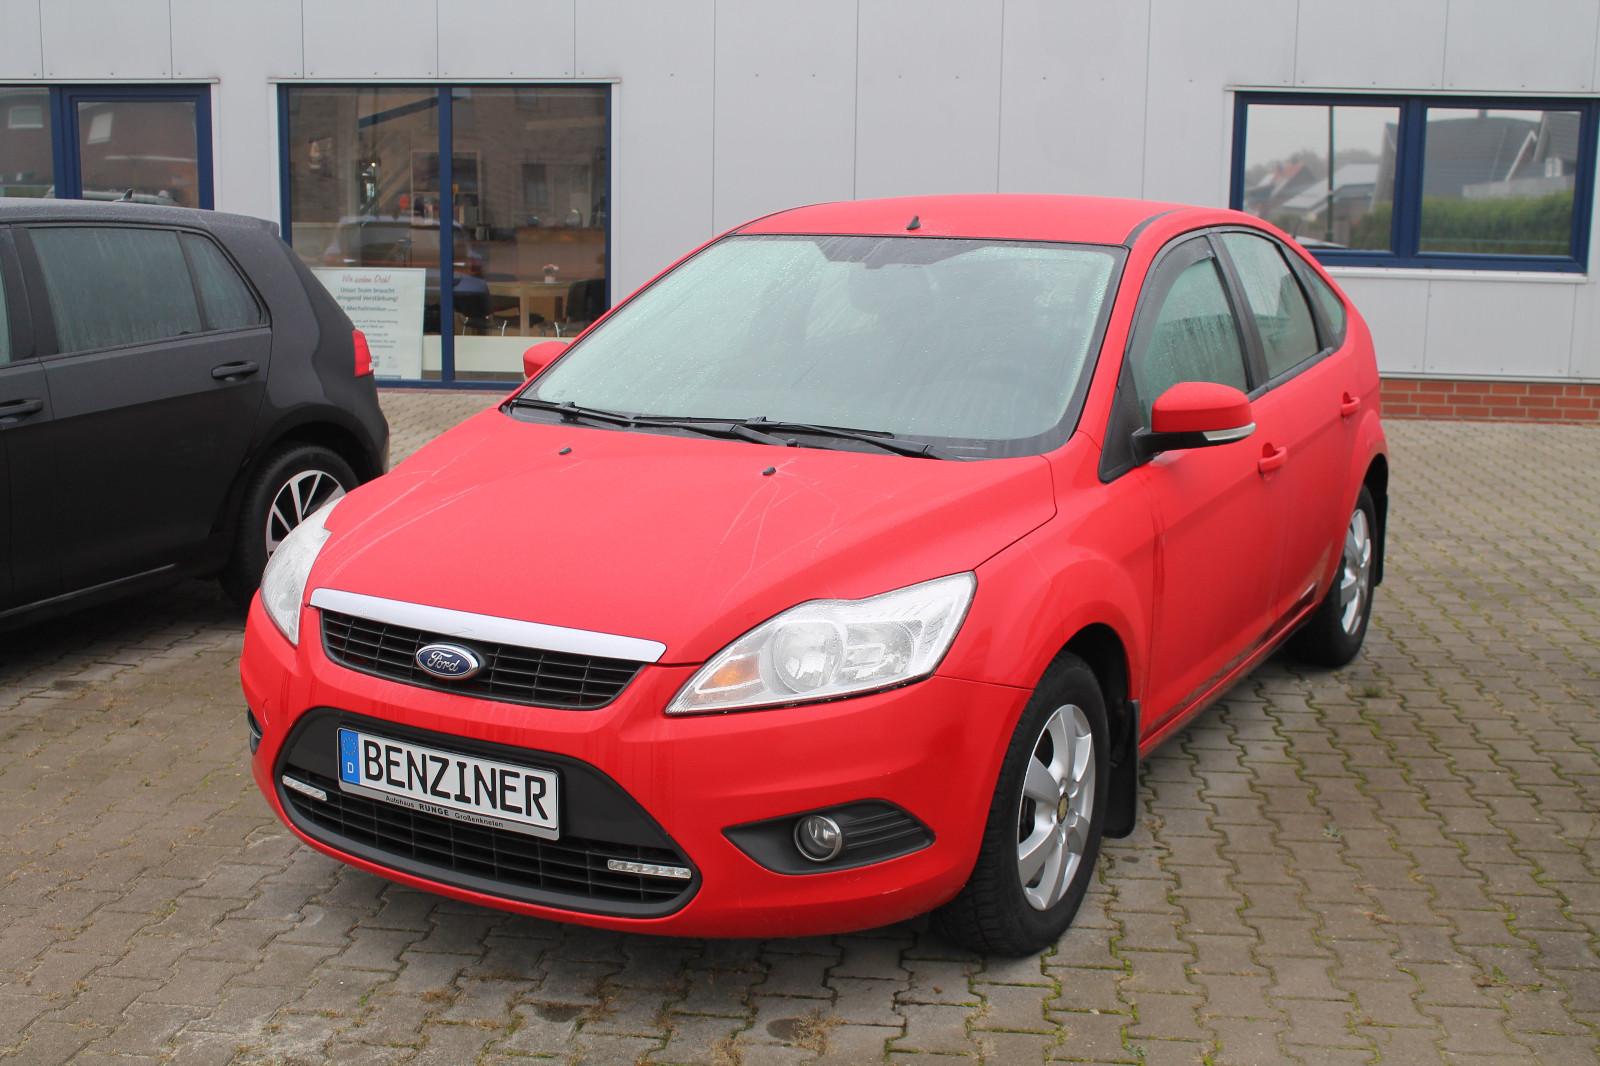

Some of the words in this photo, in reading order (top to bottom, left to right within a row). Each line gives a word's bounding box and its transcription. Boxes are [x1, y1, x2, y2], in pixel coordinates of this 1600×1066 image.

[427, 650, 460, 672] Ford
[347, 761, 354, 774] D
[363, 739, 549, 821] BENZINER
[385, 795, 415, 809] Autohaus
[418, 803, 450, 817] RUNGE
